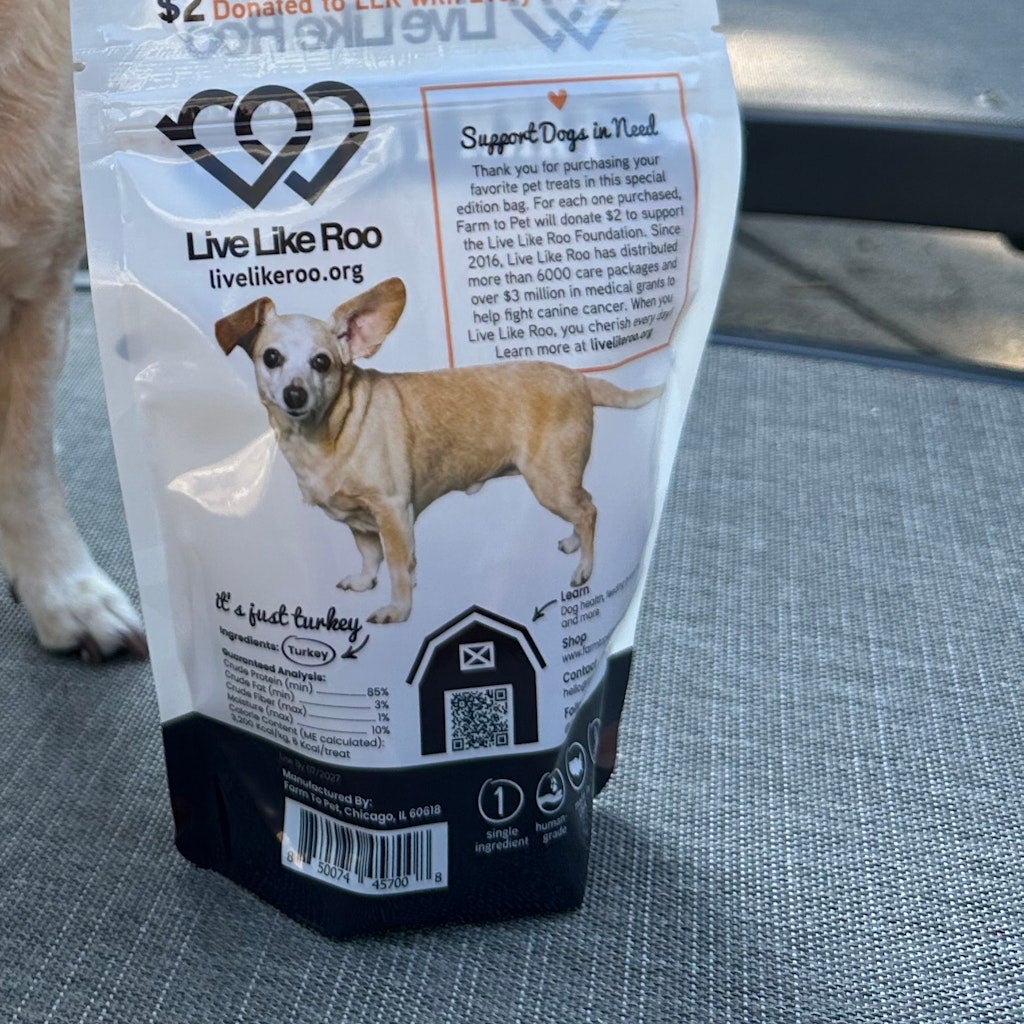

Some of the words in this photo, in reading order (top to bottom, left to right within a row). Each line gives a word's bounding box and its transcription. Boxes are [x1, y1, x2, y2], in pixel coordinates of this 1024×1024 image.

[460, 122, 539, 155] Support
[540, 121, 588, 151] Dogs
[594, 123, 612, 139] in
[612, 113, 659, 138] Need
[473, 161, 511, 177] Thank
[516, 162, 537, 178] you
[542, 160, 559, 173] for
[564, 156, 629, 174] purchasing
[634, 154, 660, 168] your
[470, 180, 518, 196] favorite
[523, 180, 541, 194] pet
[546, 177, 580, 190] treats
[585, 176, 596, 187] in
[600, 174, 621, 186] this
[625, 170, 666, 185] special
[456, 200, 499, 215] edition
[503, 199, 529, 213] bag.
[534, 196, 554, 209] For
[559, 195, 587, 208] each
[591, 194, 614, 205] one
[618, 187, 682, 204] purchased,
[456, 219, 490, 233] Farm
[494, 218, 506, 230] to
[510, 215, 530, 229] Pet
[534, 212, 556, 227] will
[560, 210, 602, 225] donate
[606, 208, 622, 222] $2
[626, 208, 638, 220] to
[641, 204, 685, 220] support
[186, 230, 250, 261] Live
[253, 226, 316, 256] Like
[320, 222, 383, 251] Roo
[464, 238, 484, 250] the
[488, 235, 514, 249] Live
[518, 232, 543, 247] Like
[547, 231, 571, 245] Roo
[576, 227, 647, 243] Foundation.
[651, 222, 681, 237] Since
[468, 255, 503, 269] 2016,
[507, 252, 533, 266] Live
[537, 250, 562, 264] Like
[567, 248, 591, 262] Roo
[594, 246, 617, 259] has
[620, 241, 679, 257] distributed
[209, 264, 364, 289] livelikeroo.org
[468, 275, 502, 288] more
[505, 271, 533, 284] than
[537, 267, 571, 282] 6000
[575, 267, 603, 279] care
[607, 261, 659, 279] packages
[661, 259, 678, 271] and
[471, 294, 499, 306] over
[503, 289, 519, 303] $3
[524, 285, 566, 301] million
[570, 285, 581, 297] in
[585, 280, 632, 296] medical
[636, 278, 665, 294] grants
[667, 276, 676, 288] to
[473, 309, 500, 324] help
[505, 306, 533, 323] fight
[537, 304, 578, 319] canine
[582, 301, 628, 315] cancer.
[631, 296, 657, 310] When
[658, 293, 673, 307] you
[468, 328, 495, 343] Live
[499, 326, 524, 340] Like
[529, 323, 557, 338] Roo,
[561, 321, 584, 335] you
[588, 316, 631, 333] cherish
[633, 312, 655, 327] every
[495, 343, 534, 359] Learn
[537, 341, 570, 355] more
[574, 340, 587, 352] at
[590, 327, 654, 351] livelikeroo.org
[561, 585, 590, 602] Learn
[248, 603, 289, 627] just
[291, 606, 363, 642] turkey
[561, 602, 578, 616] Dog
[561, 615, 578, 628] and
[581, 608, 600, 622] more
[219, 626, 279, 651] Ingredients:
[287, 644, 328, 661] Turkey
[562, 632, 587, 649] Shop
[222, 647, 275, 673] Guaranteed
[278, 664, 326, 682] Analysis:
[223, 658, 249, 675] Crude
[251, 670, 283, 687] Protein
[284, 678, 313, 694] (min)
[367, 687, 389, 697] 85%
[224, 669, 250, 687] Crude
[252, 681, 266, 693] Fat
[268, 685, 295, 702] (min)
[374, 700, 389, 710] 3%
[225, 681, 252, 699] Crude
[254, 693, 275, 707] Fiber
[277, 698, 307, 717] (max)
[378, 712, 390, 722] 1%
[262, 715, 297, 736] Content
[299, 727, 317, 742] (ME
[265, 705, 293, 724] (max)
[372, 725, 390, 735] 10%
[282, 767, 352, 805] Manufactured
[355, 796, 373, 809] By:
[284, 780, 309, 801] Farm
[311, 792, 322, 804] To
[324, 798, 342, 814] Pet,
[344, 807, 396, 824] Chicago,
[398, 811, 407, 821] IL
[409, 804, 441, 818] 60618
[494, 786, 504, 815] 1
[475, 837, 529, 853] ingredient
[486, 826, 519, 839] single
[543, 825, 567, 844] grade
[287, 850, 294, 863] 8
[317, 862, 350, 884] 50074
[372, 877, 409, 890] 45700
[435, 872, 442, 883] 8
